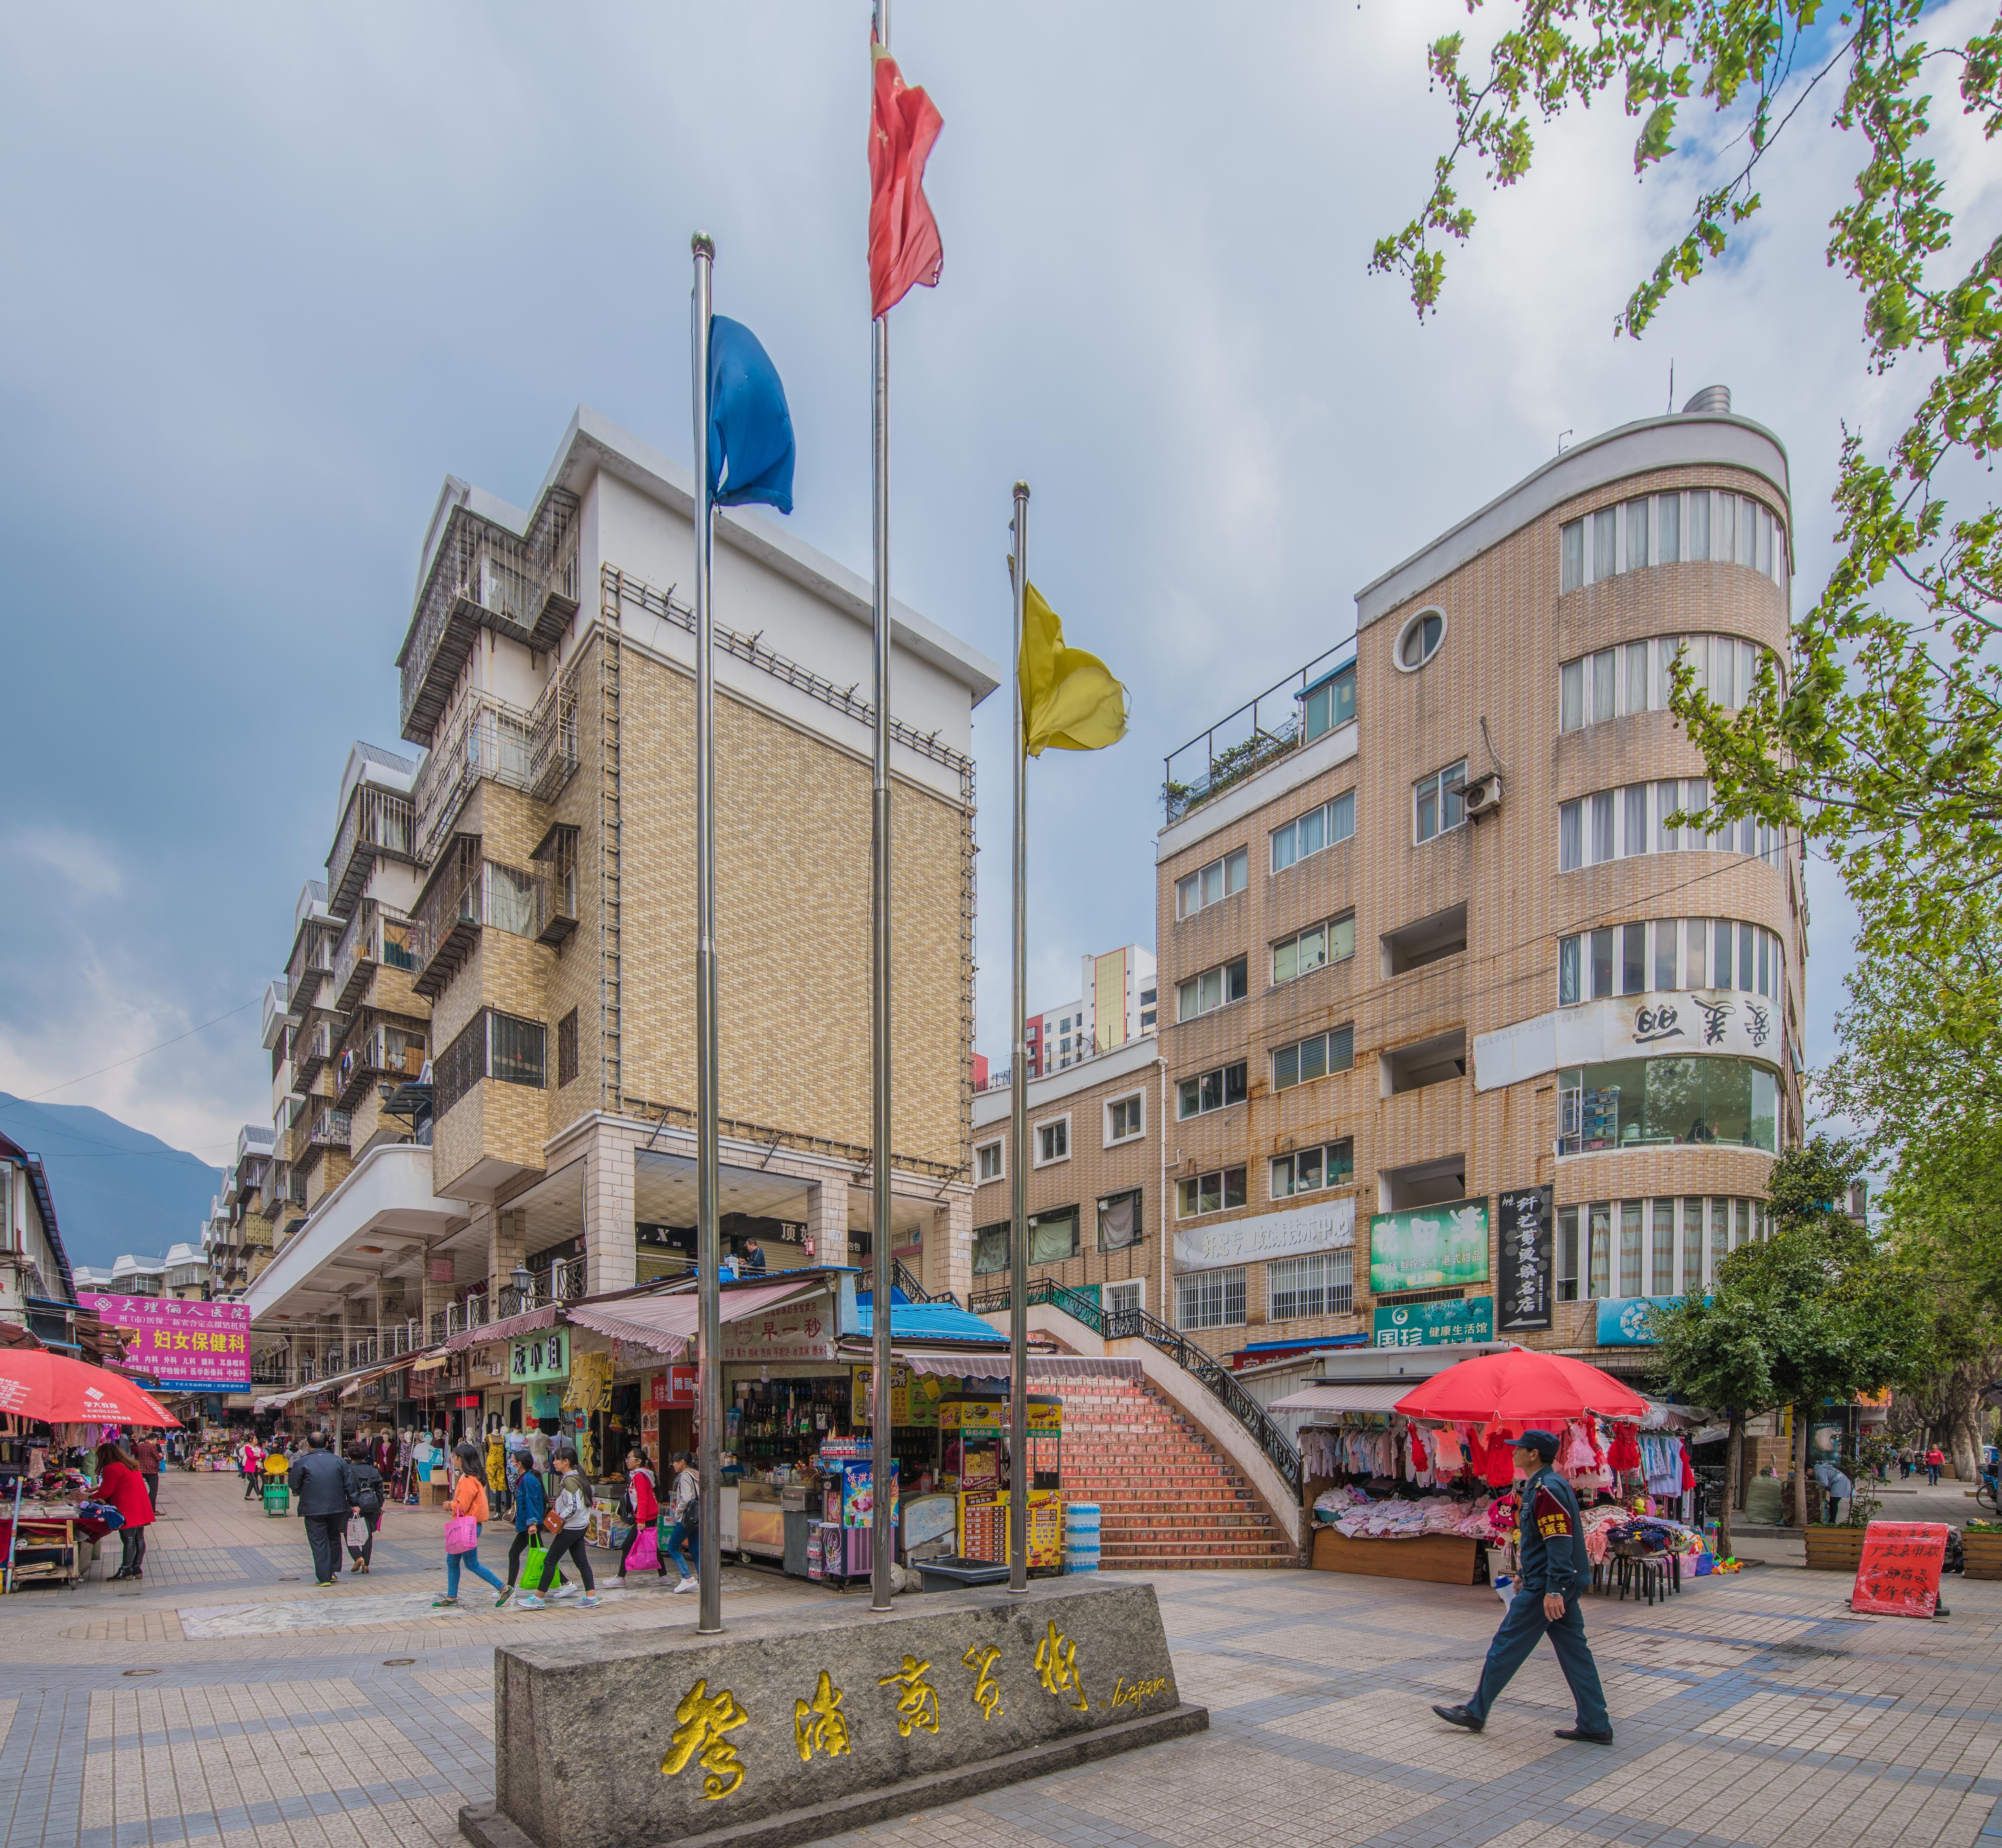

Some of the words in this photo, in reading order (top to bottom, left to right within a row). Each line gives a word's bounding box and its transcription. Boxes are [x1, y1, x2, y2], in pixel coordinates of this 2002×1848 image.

[848, 1242, 861, 1251] 包包
[1379, 1261, 1397, 1274] 火锅
[1400, 1255, 1438, 1271] 鲜榨果汁
[1441, 1250, 1482, 1266] 港式甜品
[761, 1317, 821, 1341] 早一秒
[1429, 1322, 1488, 1337] 健康生活馆
[154, 1328, 246, 1354] 妇女保健科
[725, 1349, 735, 1358] 奶茶
[736, 1348, 746, 1358] 果汁
[761, 1348, 771, 1357] 热狗
[774, 1347, 790, 1357] 手抓饼
[792, 1346, 809, 1357] 冰淇淋
[145, 1355, 158, 1363] 内科
[164, 1356, 177, 1365] 外科
[183, 1357, 196, 1365] 儿科
[201, 1357, 214, 1366] 眼科
[219, 1359, 245, 1368] 耳鼻喉科
[153, 1366, 187, 1375] 医学检验科
[190, 1368, 224, 1377] 医学影像科
[227, 1369, 246, 1377] 中医科
[1884, 1526, 1932, 1540] 好消息
[1870, 1562, 1927, 1582] 全部商品
